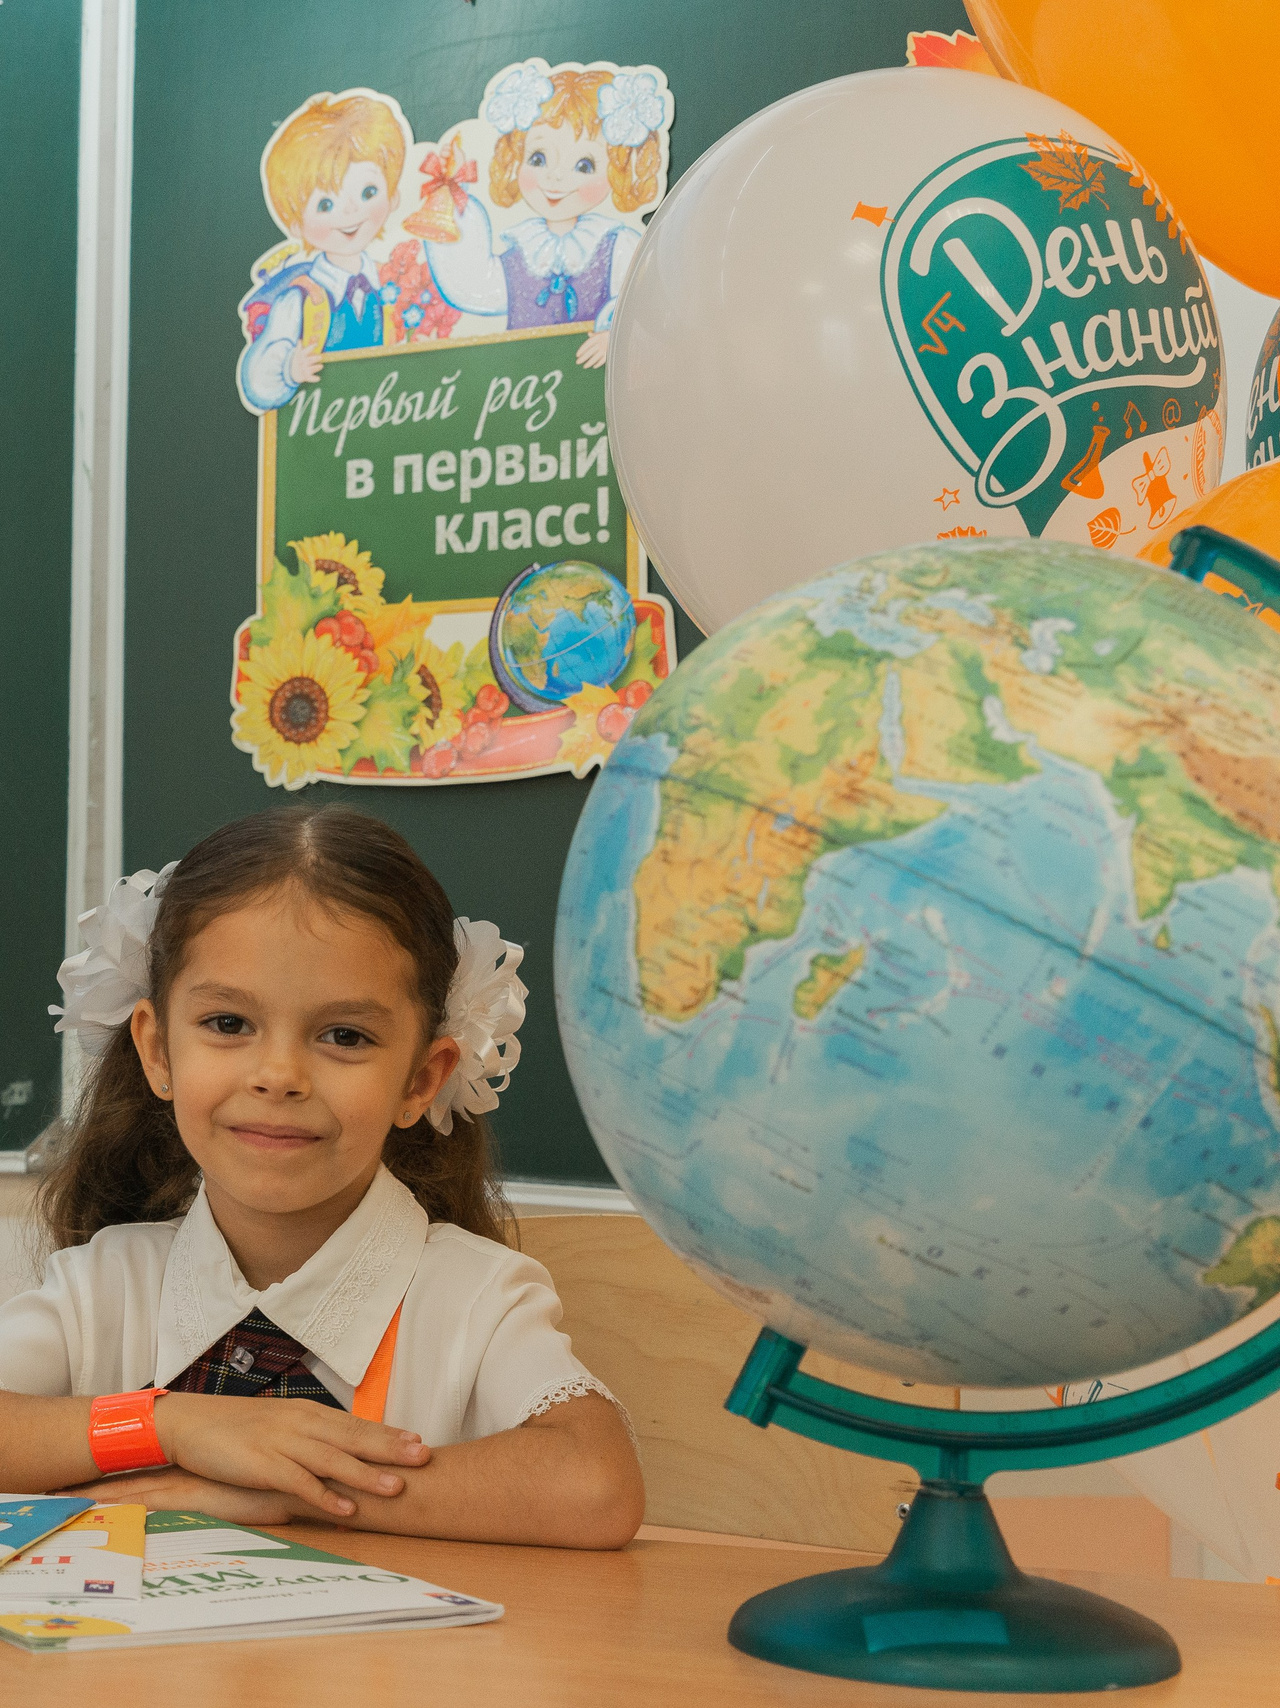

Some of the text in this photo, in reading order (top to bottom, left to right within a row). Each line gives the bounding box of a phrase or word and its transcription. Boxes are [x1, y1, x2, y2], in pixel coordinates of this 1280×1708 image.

[909, 197, 1168, 337] День
[287, 369, 565, 457] Первый раз
[957, 280, 1218, 506] Знаний
[345, 421, 608, 504] в первый
[435, 487, 611, 555] класс!
[141, 1573, 410, 1600] Окружаю
